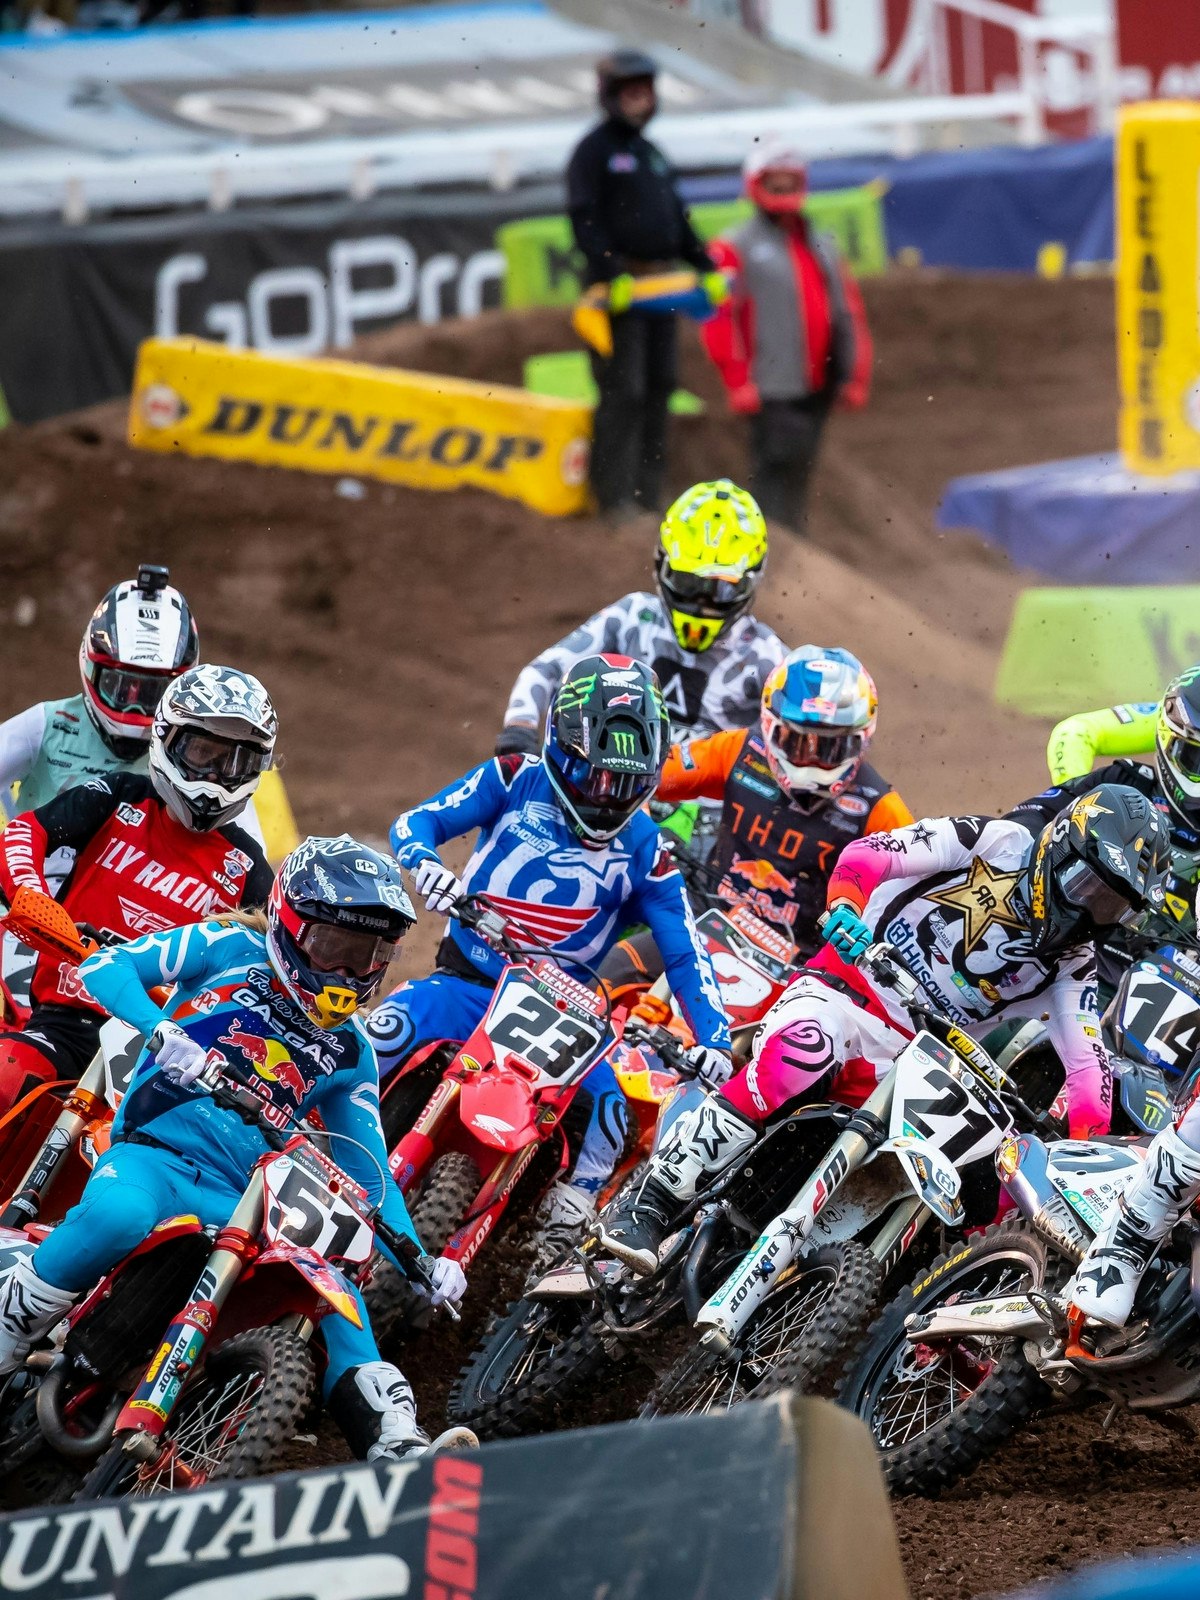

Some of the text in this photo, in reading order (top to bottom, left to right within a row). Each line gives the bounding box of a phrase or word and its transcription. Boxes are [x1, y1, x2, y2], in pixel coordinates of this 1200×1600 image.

[155, 236, 507, 357] GoPro
[1134, 140, 1166, 460] LEADER
[203, 396, 545, 472] DUNLOP
[602, 680, 645, 692] HONDA
[602, 757, 648, 770] MONSTER
[507, 822, 552, 854] SHOWA
[517, 811, 555, 841] HONDA
[5, 844, 45, 896] RACIN
[133, 860, 232, 919] RACIN
[337, 908, 390, 928] METHOD
[538, 969, 598, 1014] RENTHAL
[543, 961, 603, 1007] RENTHAL
[232, 987, 338, 1077] GASGAS
[489, 996, 599, 1079] 23
[471, 1119, 507, 1148] HONDA
[903, 1069, 996, 1168] 21
[298, 1155, 330, 1183] MONSTER
[1053, 1176, 1069, 1191] KTM
[269, 1165, 362, 1262] 51
[1090, 1191, 1109, 1213] GEAR
[912, 1247, 974, 1299] DUNLOP
[158, 1336, 189, 1395] DUNLOP
[134, 1400, 167, 1420] ACERBIS
[1, 1461, 420, 1591] UNTAIN
